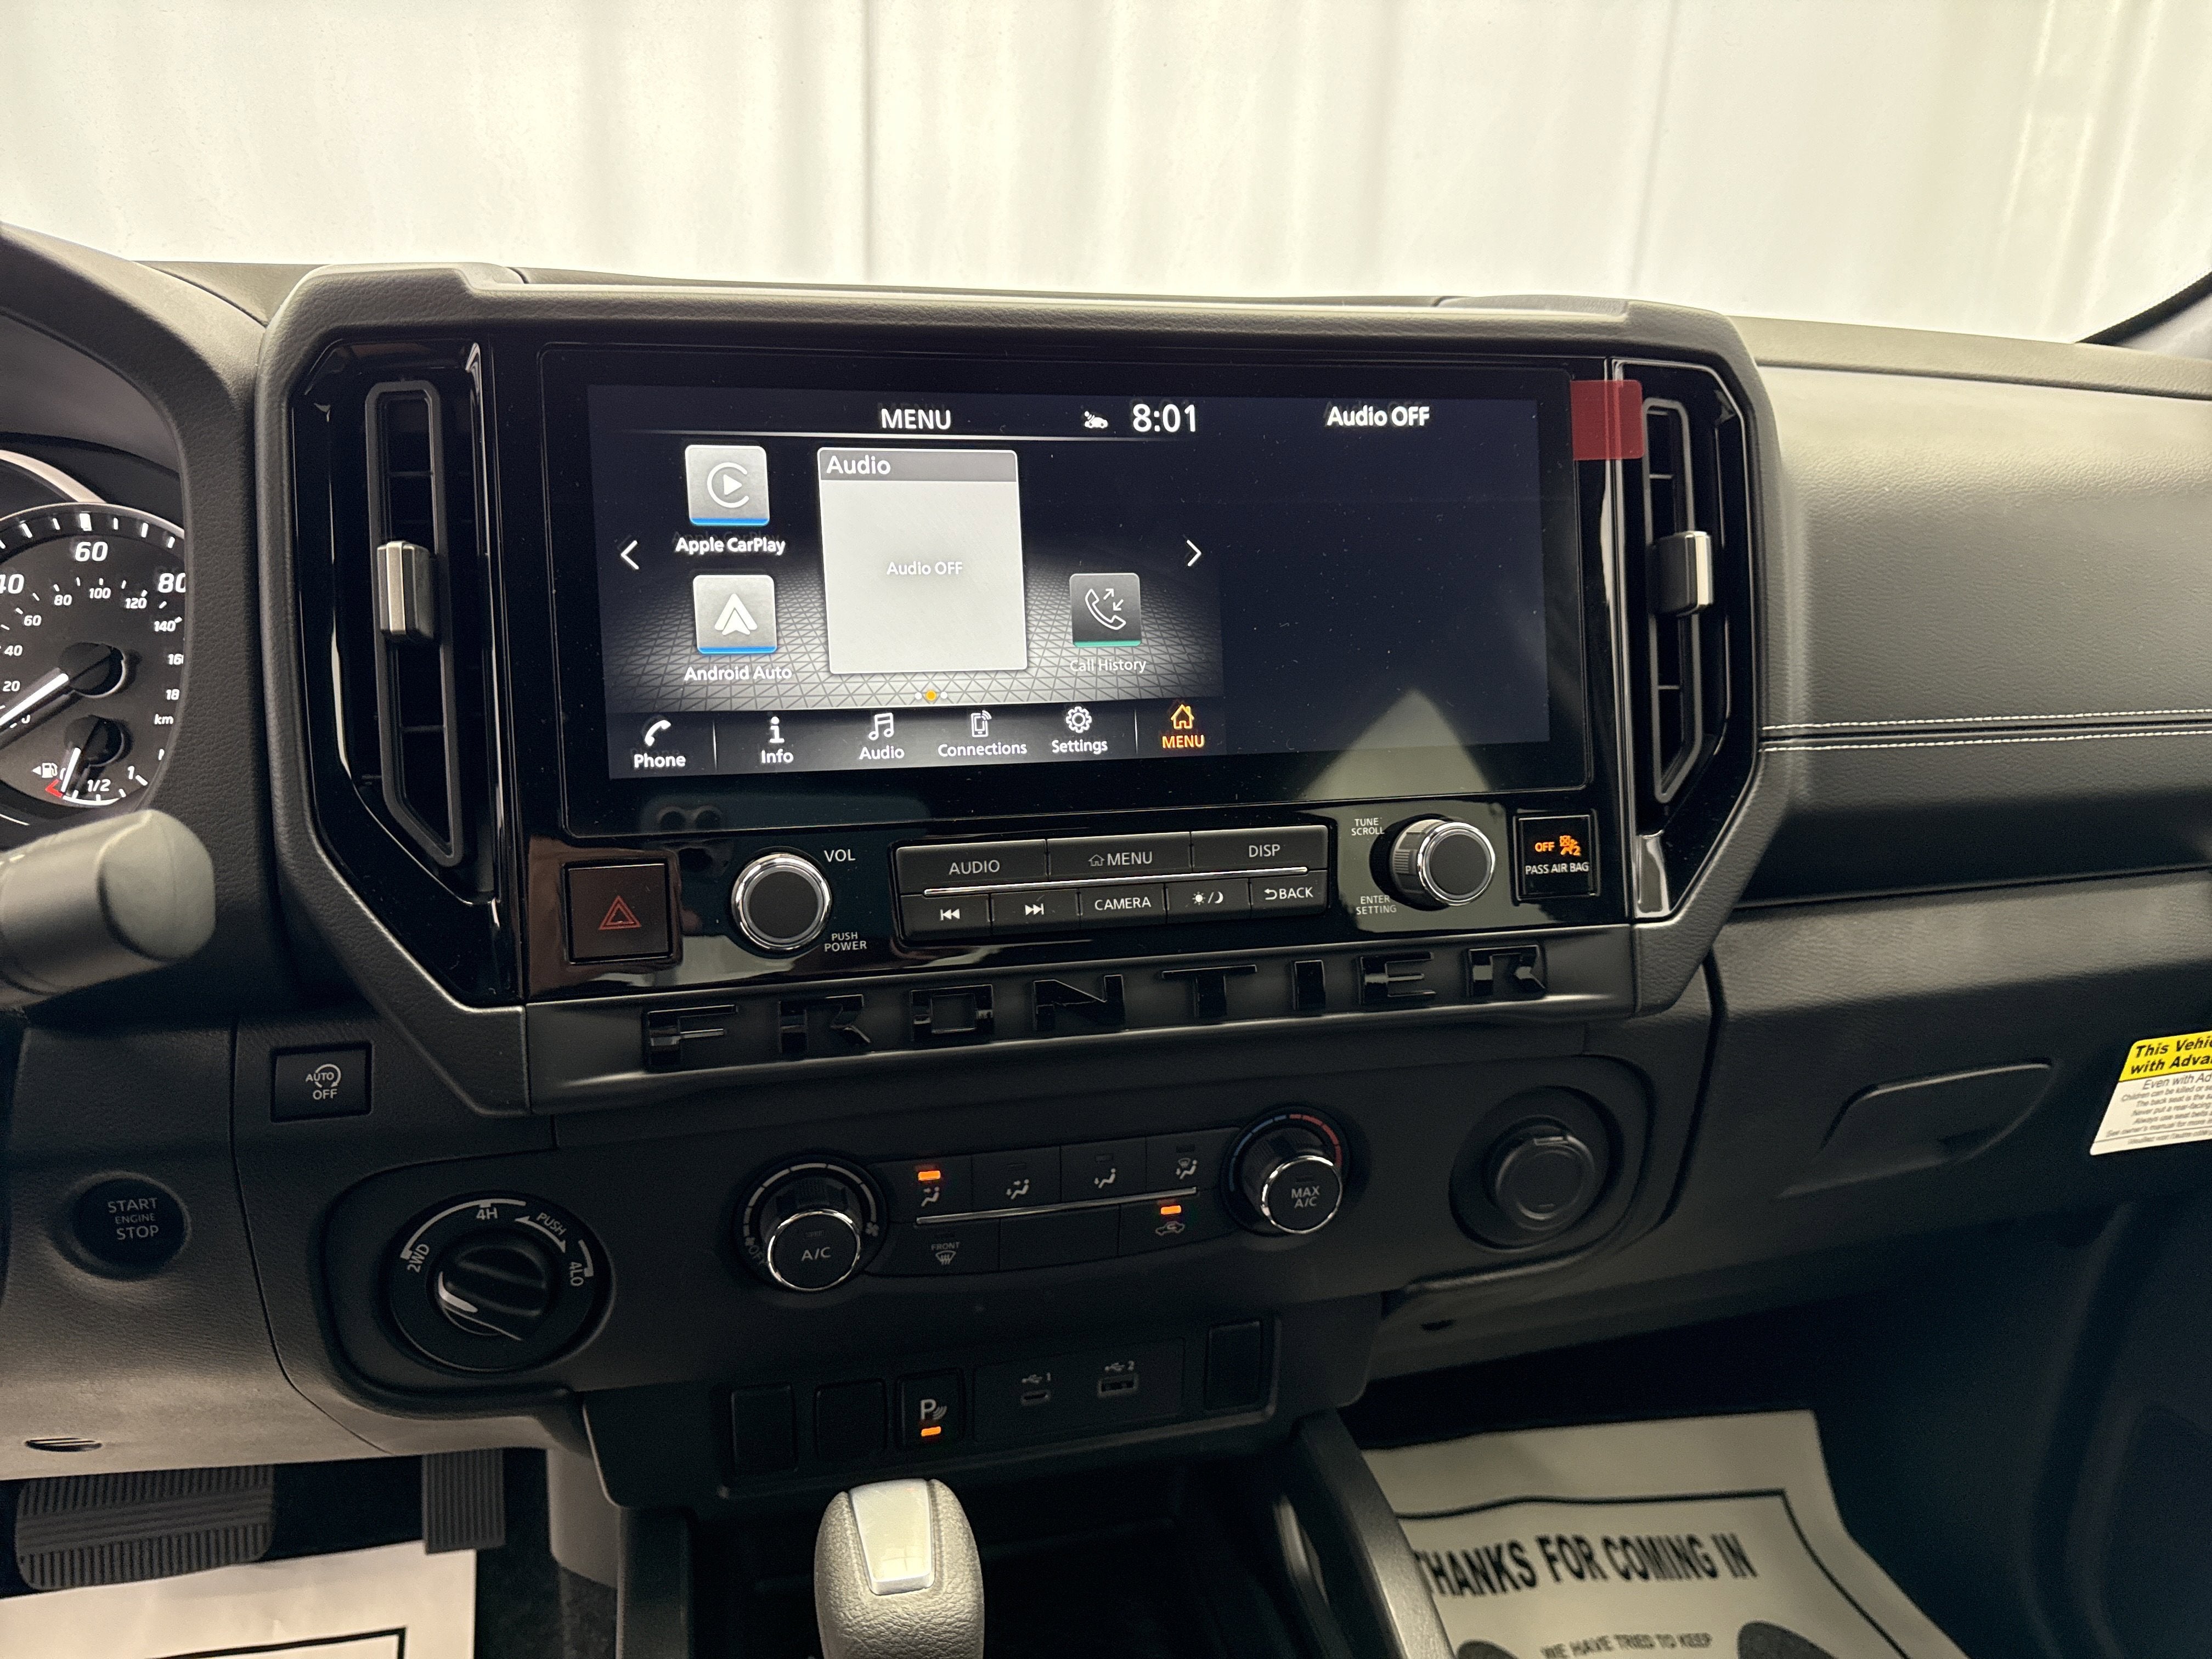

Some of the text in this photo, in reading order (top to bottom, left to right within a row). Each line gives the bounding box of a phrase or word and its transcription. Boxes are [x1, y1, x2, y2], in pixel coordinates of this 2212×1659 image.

[881, 409, 951, 429] MENU
[1132, 403, 1196, 433] 8:01
[1327, 405, 1430, 427] Audio OFF
[826, 455, 891, 475] Audio
[75, 541, 109, 562] 60
[675, 537, 786, 556] Apple CarPlay
[887, 561, 962, 575] Audio OFF
[158, 573, 185, 593] 80
[54, 594, 72, 606] 80
[89, 588, 111, 599] 100
[126, 597, 147, 609] 120
[24, 615, 42, 627] 60
[154, 620, 176, 631] 140
[4, 645, 22, 656] 40
[684, 665, 792, 681] Android Auto
[1070, 658, 1147, 674] Call History
[3, 680, 21, 692] 20
[166, 689, 180, 700] 18
[1052, 739, 1108, 754] Settings
[1162, 734, 1205, 748] MENU
[761, 749, 794, 764] Info
[859, 745, 905, 760] Audio
[938, 742, 1027, 757] Connections
[634, 753, 686, 768] Phone
[127, 766, 135, 778] 1
[87, 779, 110, 792] 1/2
[1355, 817, 1379, 827] TUNE
[1351, 826, 1385, 836] SCROLL
[1249, 844, 1280, 858] DISP
[1534, 841, 1555, 852] OFF
[823, 849, 855, 862] VOL
[1107, 851, 1153, 866] MENU
[949, 859, 1000, 876] AUDIO
[1525, 861, 1589, 875] PASS AIR BAG
[1279, 886, 1314, 900] BACK
[1360, 894, 1390, 905] ENTER
[1094, 896, 1152, 911] CAMERA
[1356, 904, 1397, 915] SETTING
[831, 931, 858, 941] PUSH
[823, 940, 867, 952] POWER
[2135, 1042, 2169, 1058] This
[2131, 1053, 2212, 1075] with Adva
[306, 1071, 335, 1082] AUTO
[2143, 1079, 2170, 1090] Even
[2172, 1074, 2194, 1086] with
[313, 1088, 337, 1100] OFF
[1291, 1185, 1321, 1199] MAX
[108, 1198, 157, 1214] START
[1294, 1197, 1318, 1209] A/C
[115, 1212, 156, 1224] ENGINE
[476, 1207, 498, 1220] 4H
[536, 1212, 567, 1237] PUSH
[116, 1225, 159, 1241] STOP
[800, 1246, 832, 1261] A/C
[931, 1242, 960, 1251] FRONT
[407, 1243, 430, 1273] 2WD
[568, 1261, 584, 1287] 4LO
[1127, 1361, 1135, 1371] 2
[1046, 1372, 1052, 1382] 1
[920, 1399, 936, 1420] P
[1536, 1534, 1607, 1583] FOR
[1601, 1534, 1718, 1581] COMING
[1710, 1532, 1758, 1580] IN
